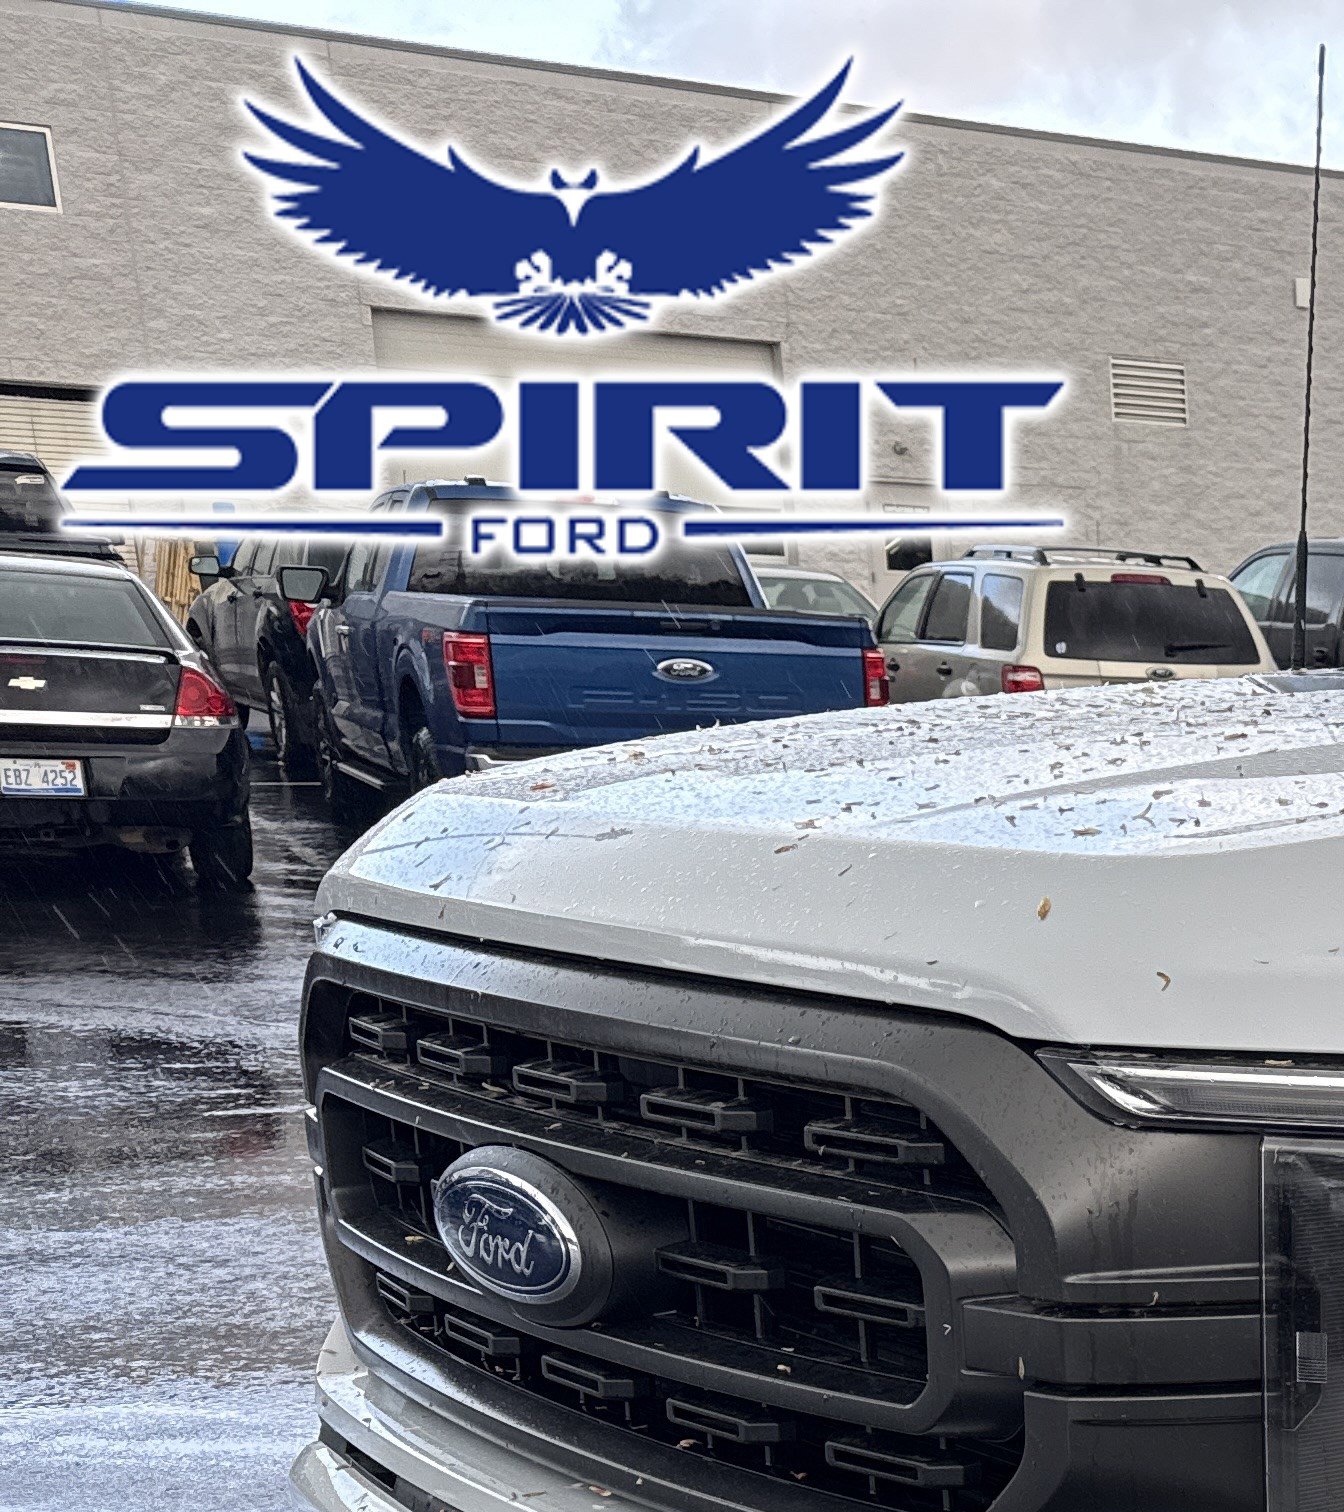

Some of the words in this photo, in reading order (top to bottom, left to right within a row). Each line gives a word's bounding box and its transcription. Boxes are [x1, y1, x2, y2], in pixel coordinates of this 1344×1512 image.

[3, 767, 32, 787] EBZ
[41, 768, 78, 788] 4252
[457, 1193, 535, 1277] Ford
